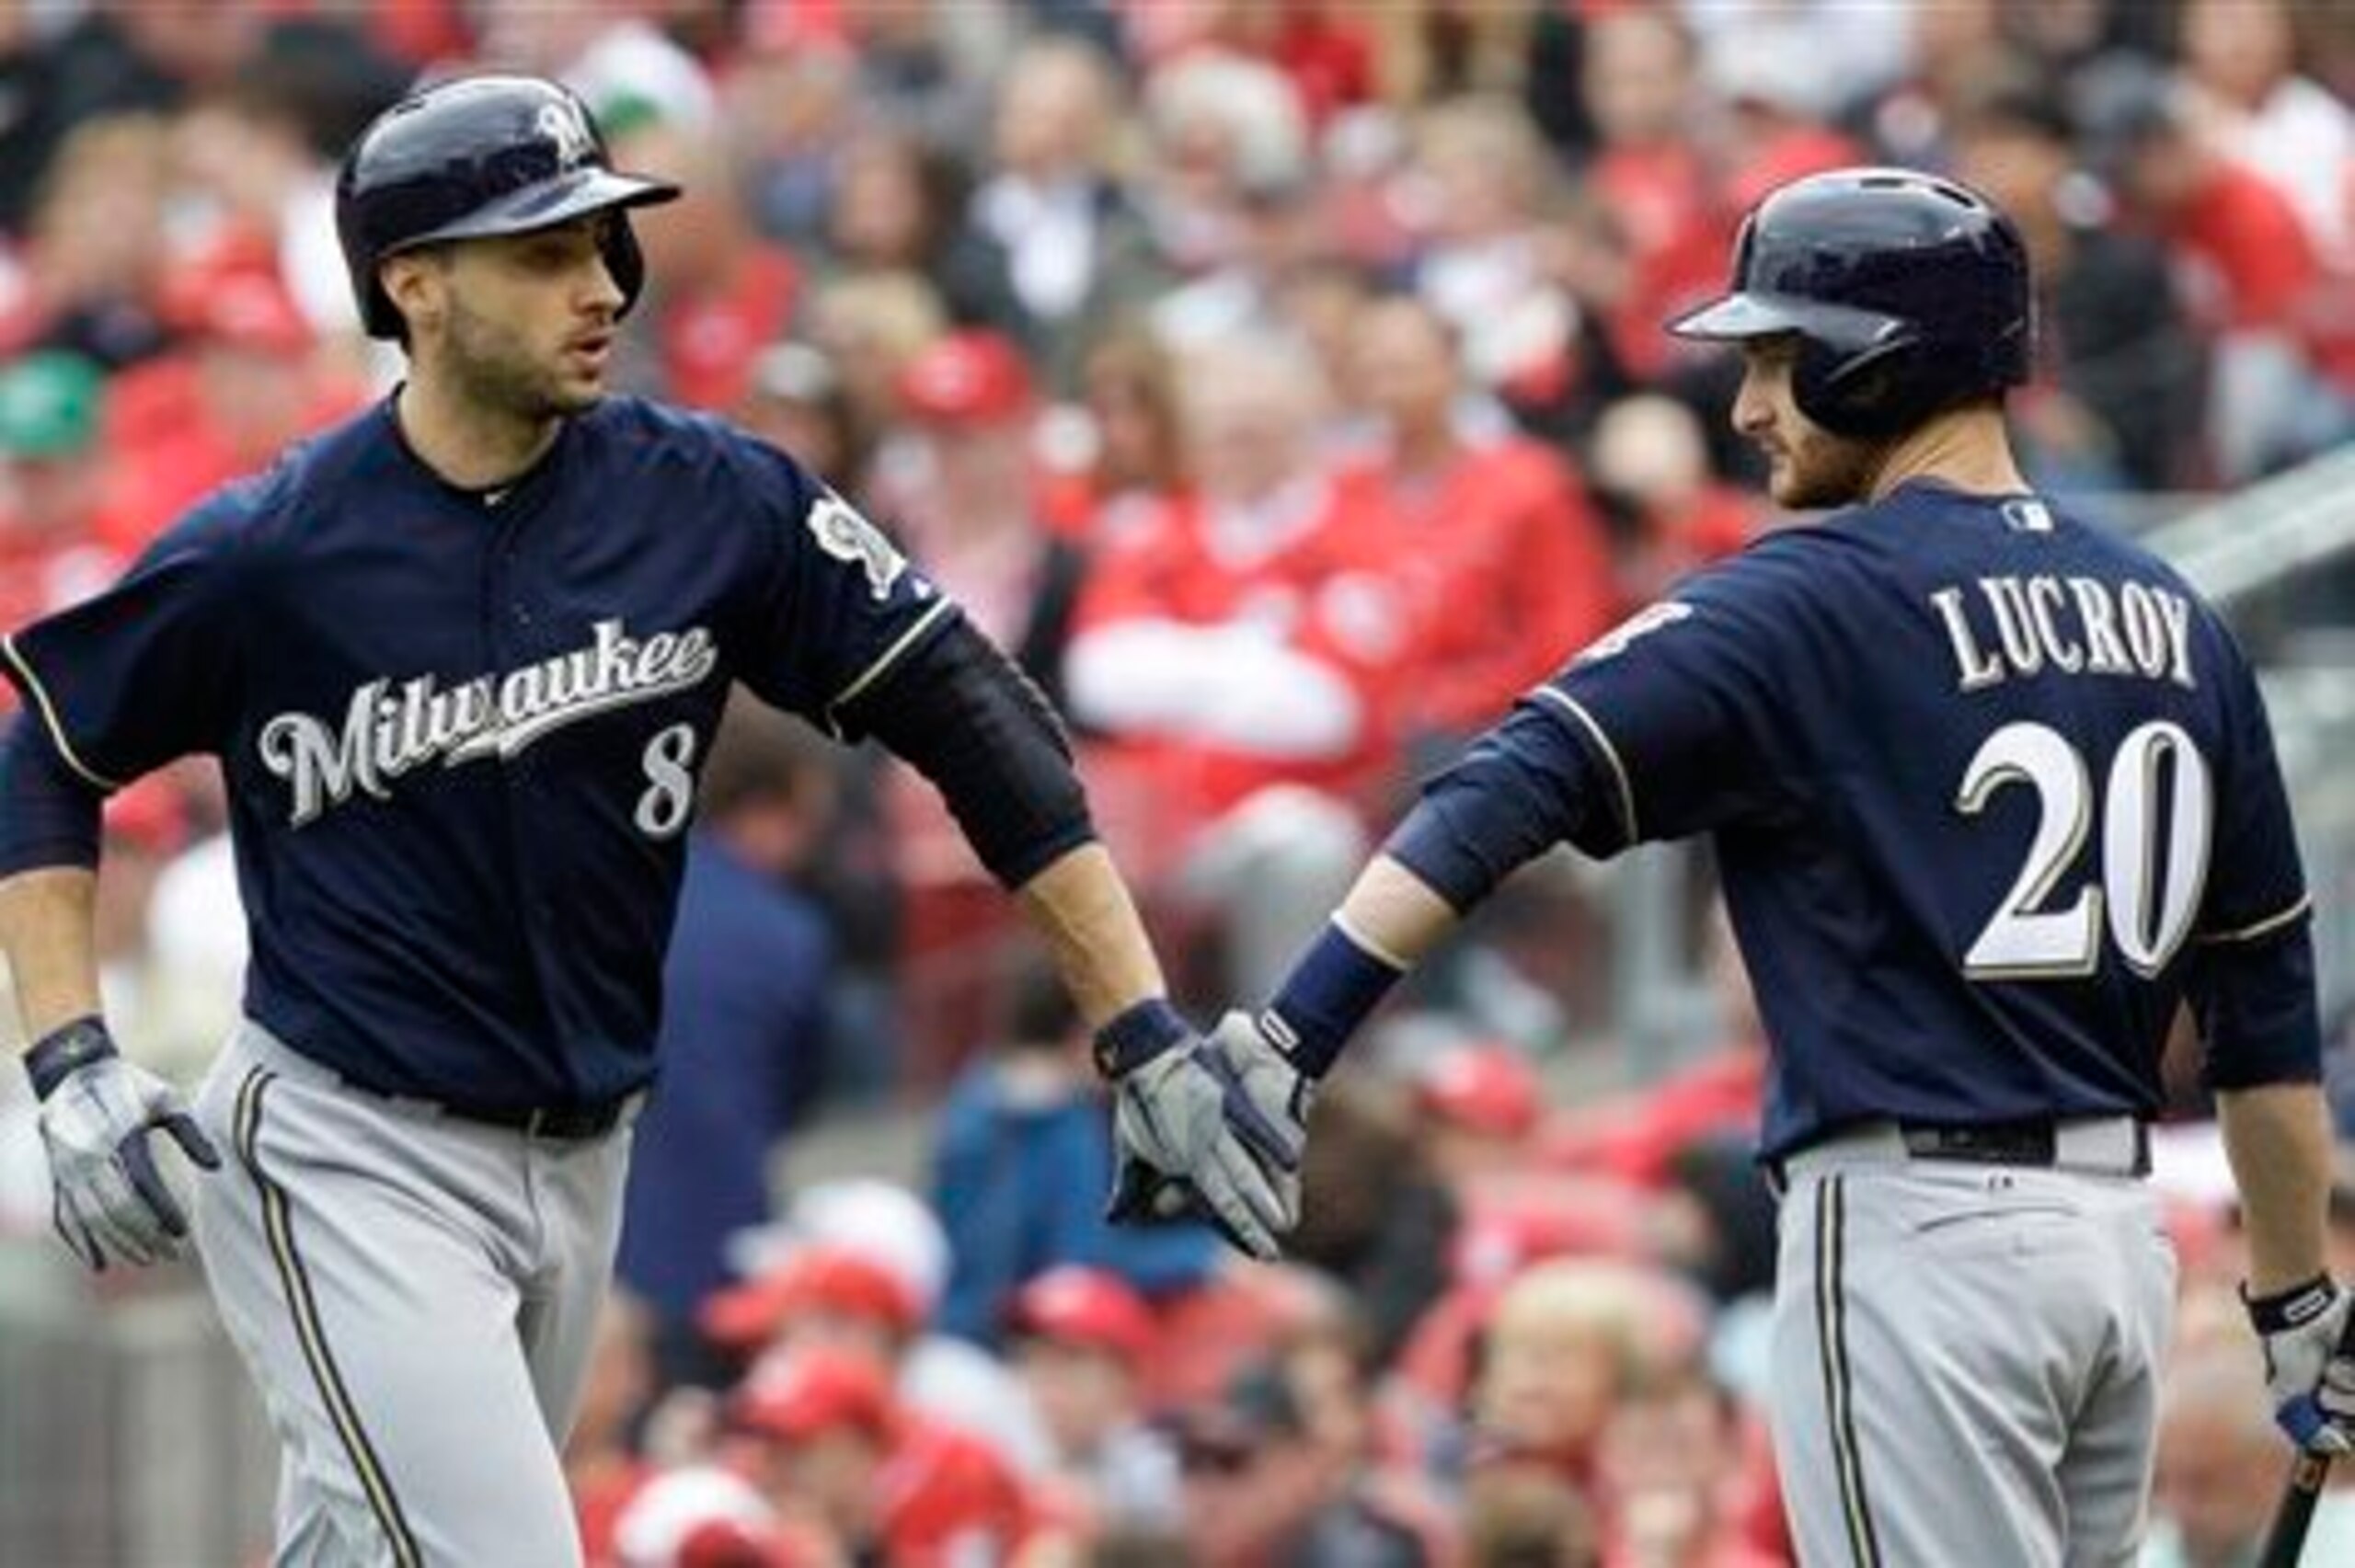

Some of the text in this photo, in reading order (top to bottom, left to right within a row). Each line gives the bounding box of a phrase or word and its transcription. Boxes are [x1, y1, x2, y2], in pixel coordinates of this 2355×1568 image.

[1931, 575, 2196, 690] LUCROY
[259, 618, 718, 828] Milwaukee
[633, 722, 697, 841] 8
[1955, 720, 2211, 981] 20
